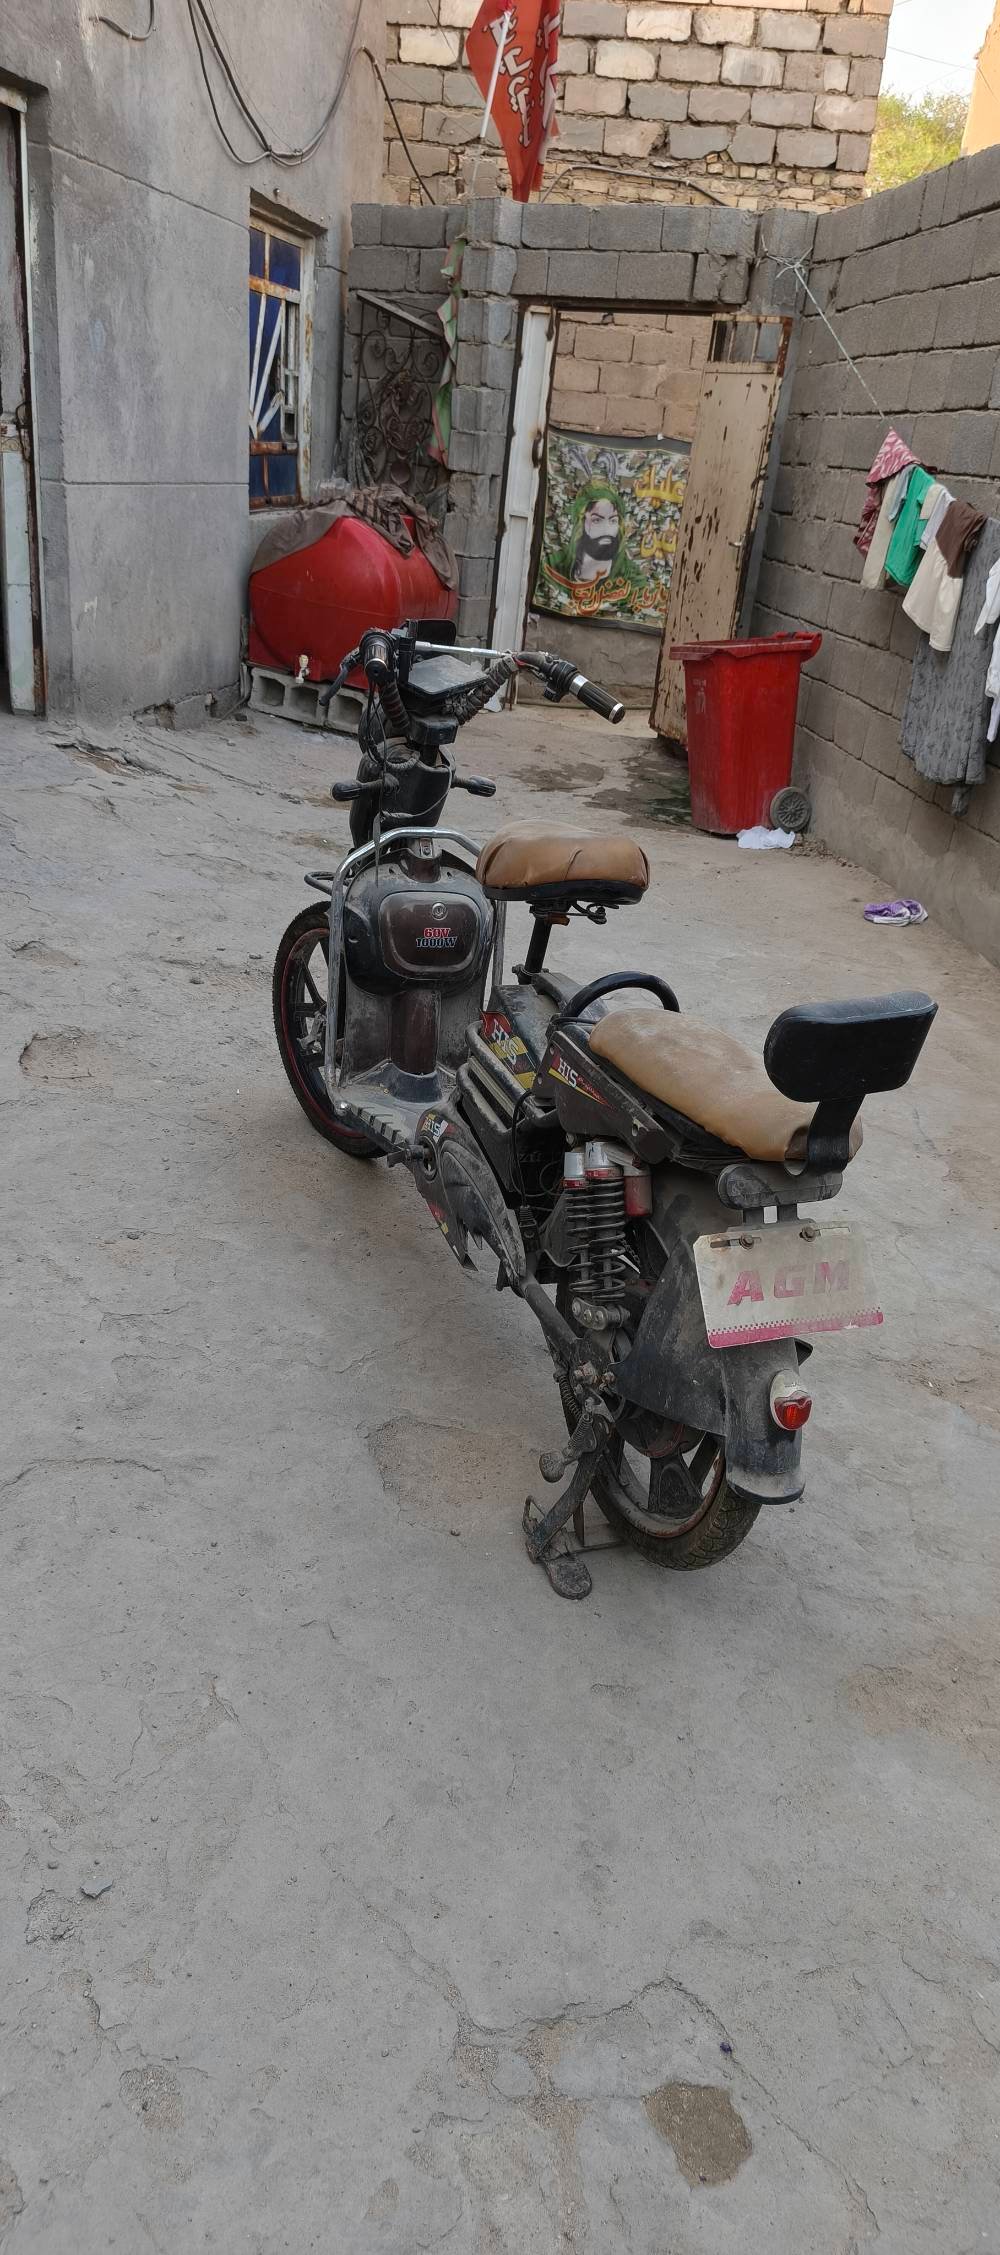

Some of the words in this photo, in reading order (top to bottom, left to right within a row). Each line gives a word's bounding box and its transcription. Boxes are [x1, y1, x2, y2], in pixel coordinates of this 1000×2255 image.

[415, 936, 458, 948] 1000W
[423, 927, 451, 938] 60V
[556, 1057, 580, 1089] HIS
[726, 1260, 851, 1307] AGM
